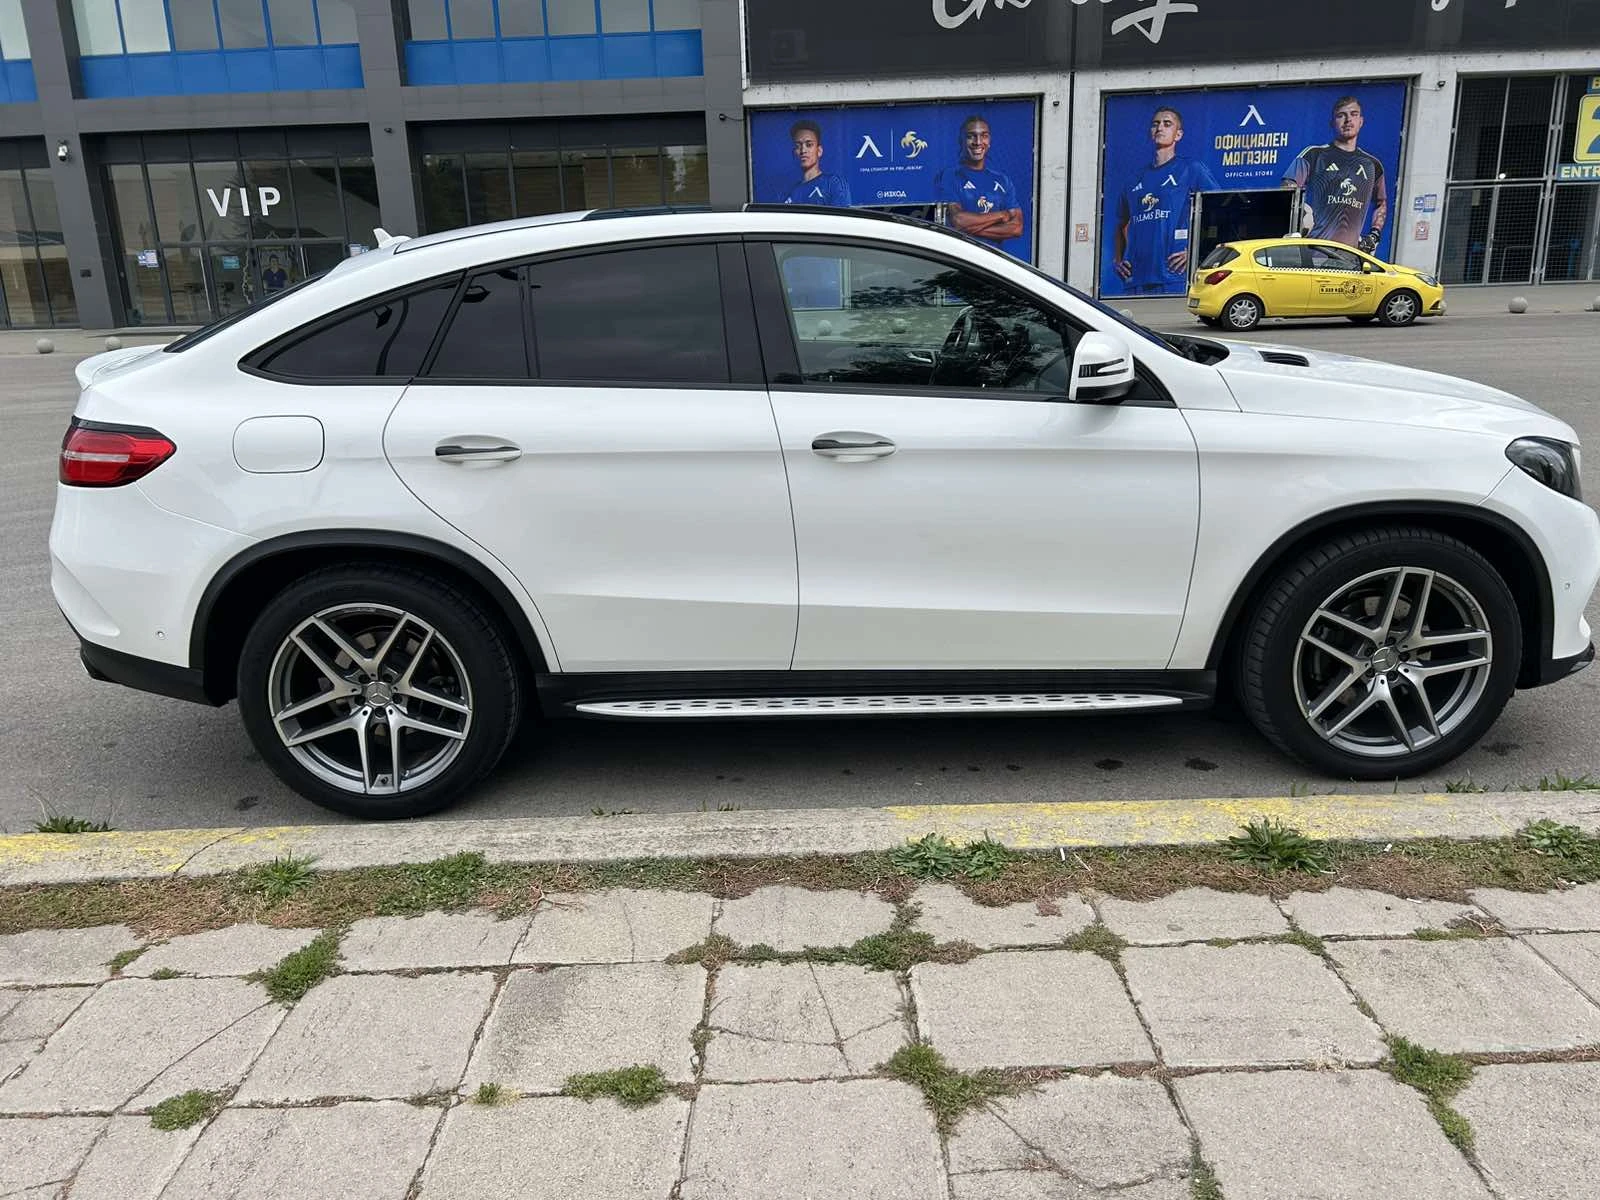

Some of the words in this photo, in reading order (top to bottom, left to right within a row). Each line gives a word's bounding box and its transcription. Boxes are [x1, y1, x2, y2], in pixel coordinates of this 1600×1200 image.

[1215, 132, 1288, 149] ОФИЦИАЛЕН
[1222, 149, 1277, 166] МАГАЗИН
[206, 187, 280, 217] VIP
